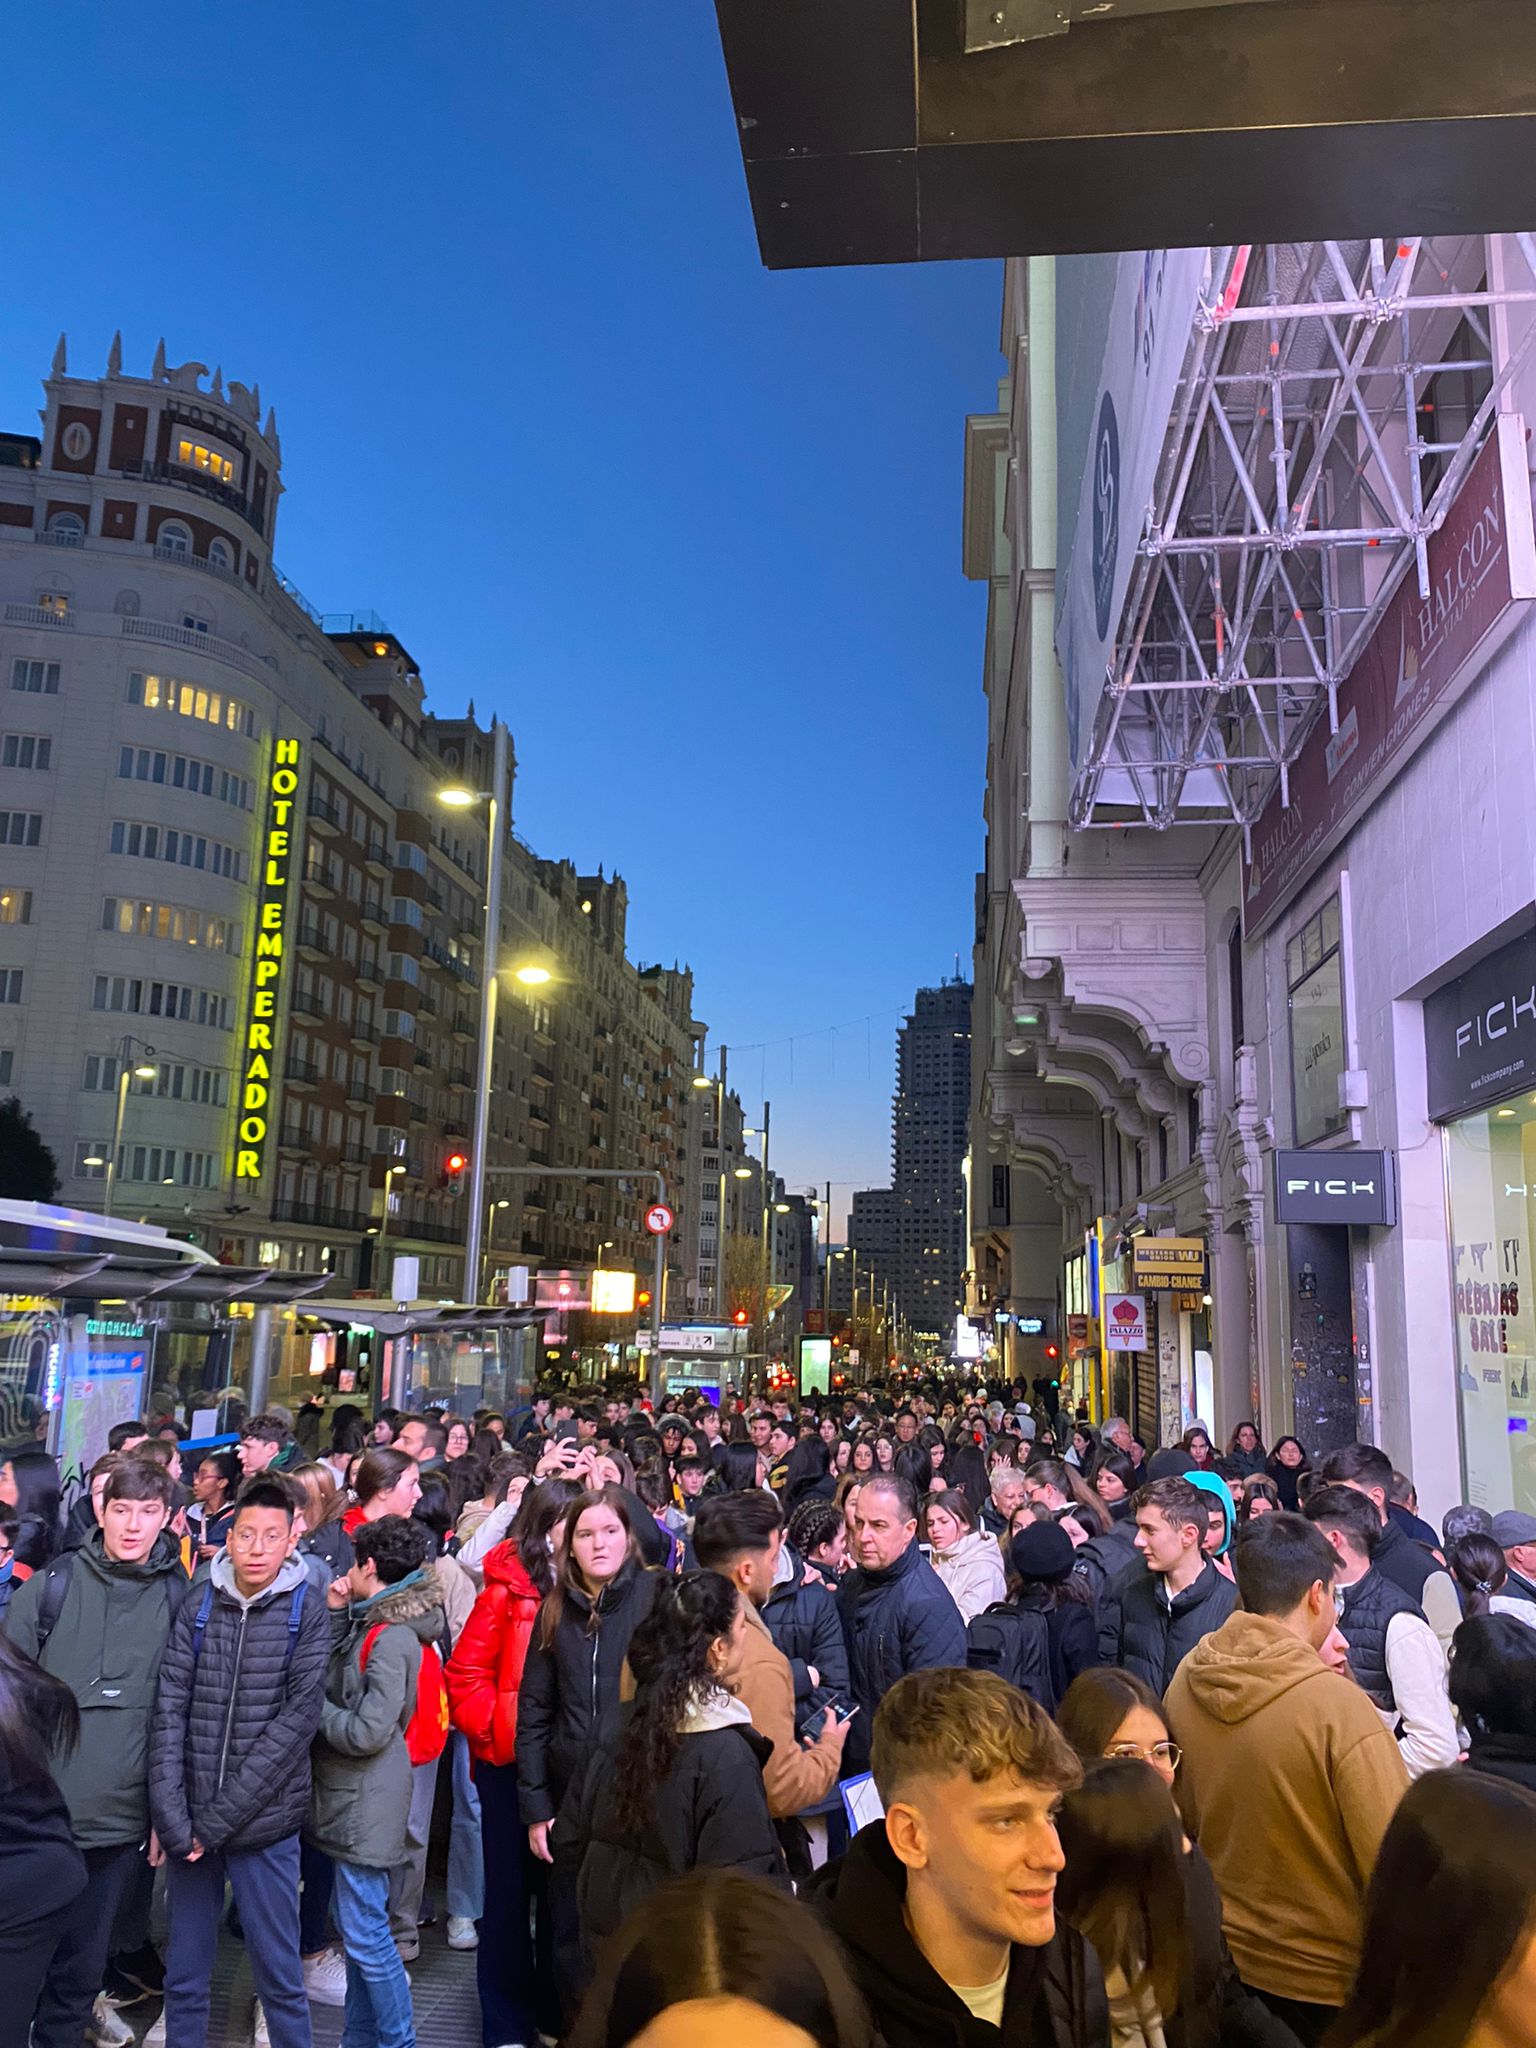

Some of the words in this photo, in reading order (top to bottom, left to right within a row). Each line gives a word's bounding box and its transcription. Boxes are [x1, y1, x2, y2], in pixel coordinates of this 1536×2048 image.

[165, 399, 251, 455] HOTEL
[1343, 678, 1431, 806] CONVENCIONES
[265, 739, 298, 886] HOTEL
[236, 903, 283, 1178] EMPERADOR
[1456, 985, 1536, 1058] FICK
[1471, 1059, 1525, 1089] www.fickcompany.com
[1287, 1180, 1375, 1195] FICK
[1178, 1250, 1199, 1262] WU
[1456, 1278, 1519, 1317] REBAJAS
[1109, 1327, 1144, 1335] PALAZZO
[1469, 1317, 1508, 1354] SALE
